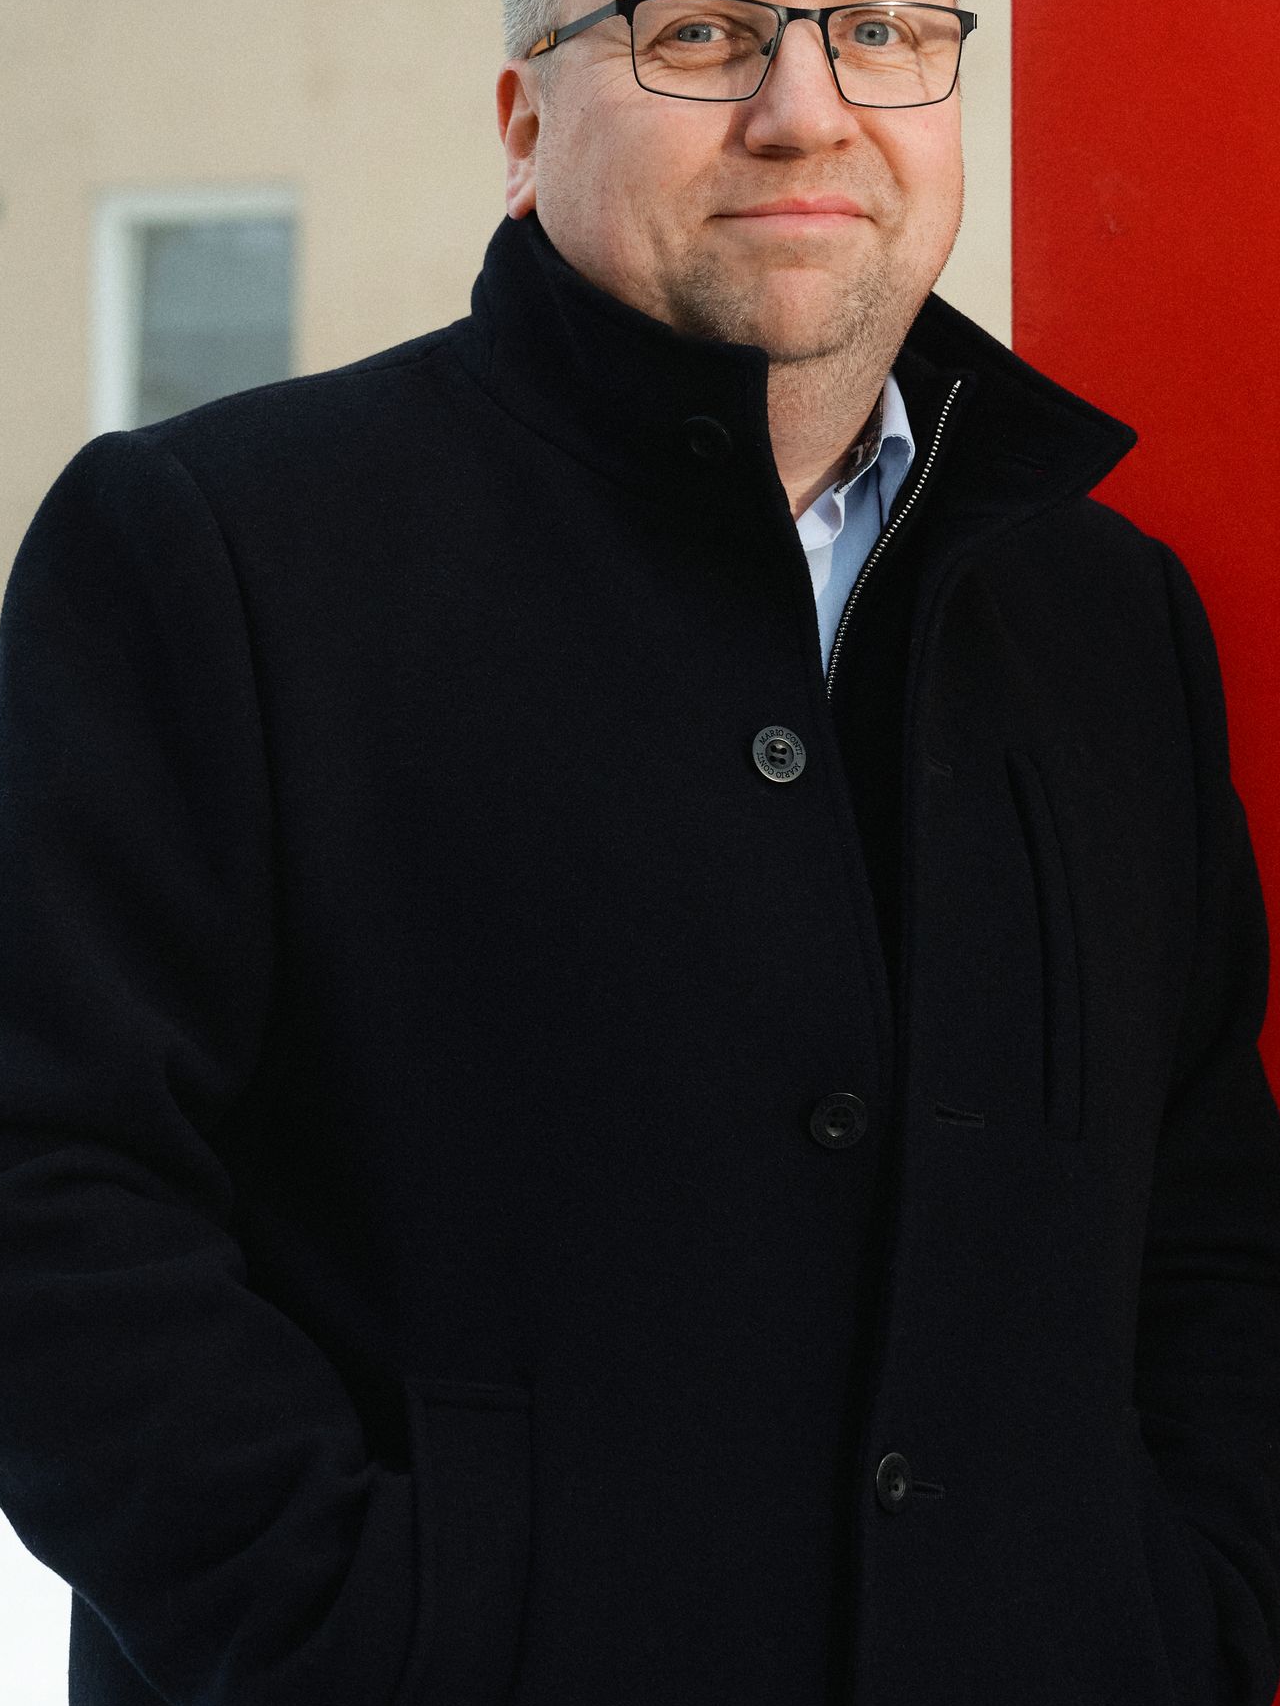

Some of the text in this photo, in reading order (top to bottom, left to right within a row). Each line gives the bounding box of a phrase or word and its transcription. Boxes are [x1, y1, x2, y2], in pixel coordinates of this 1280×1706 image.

[759, 729, 803, 755] MARIO CONTI
[757, 752, 801, 779] MARIO CONTI
